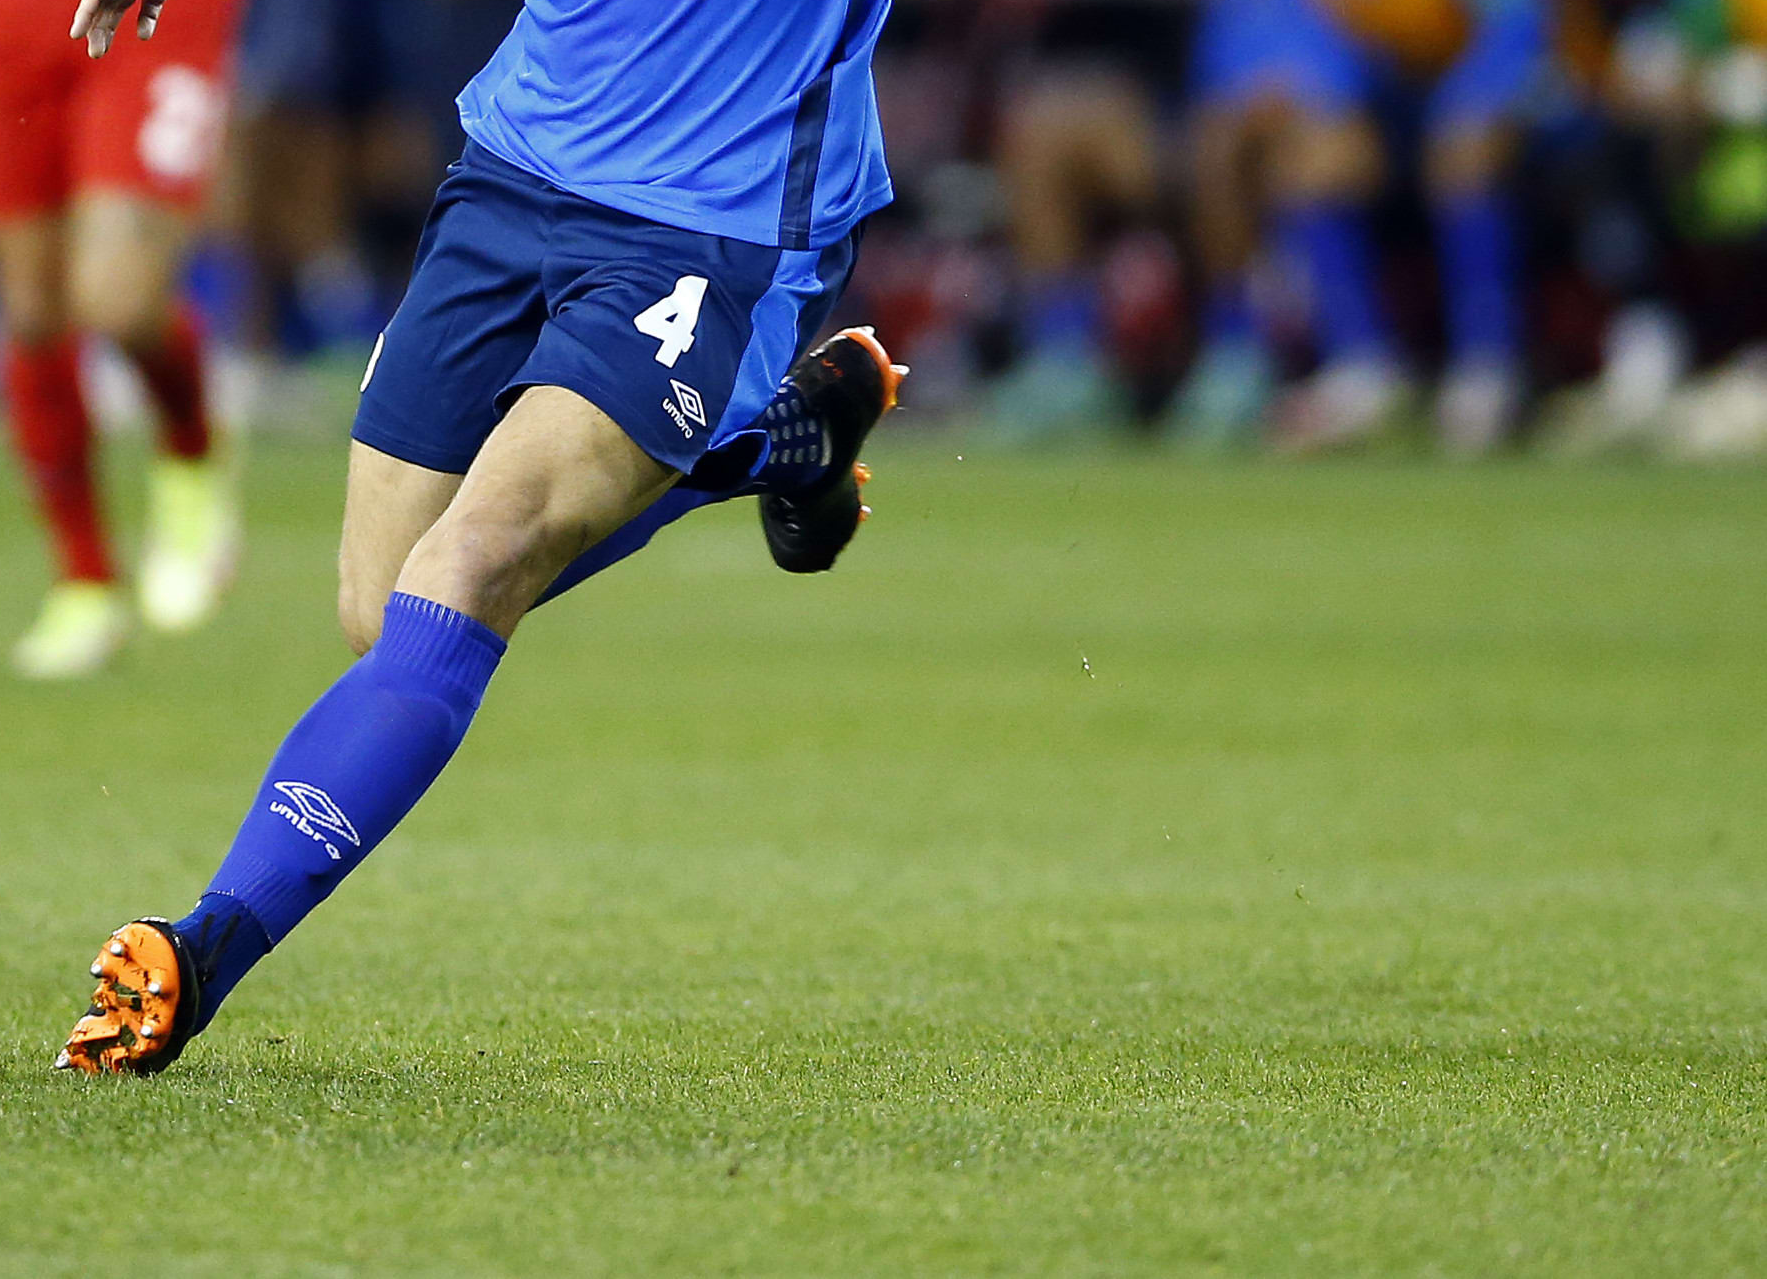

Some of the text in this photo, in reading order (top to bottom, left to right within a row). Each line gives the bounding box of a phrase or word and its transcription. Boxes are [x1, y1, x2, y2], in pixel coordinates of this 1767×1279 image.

[633, 274, 709, 369] 4
[662, 398, 693, 439] umbro
[269, 800, 342, 860] umbro
